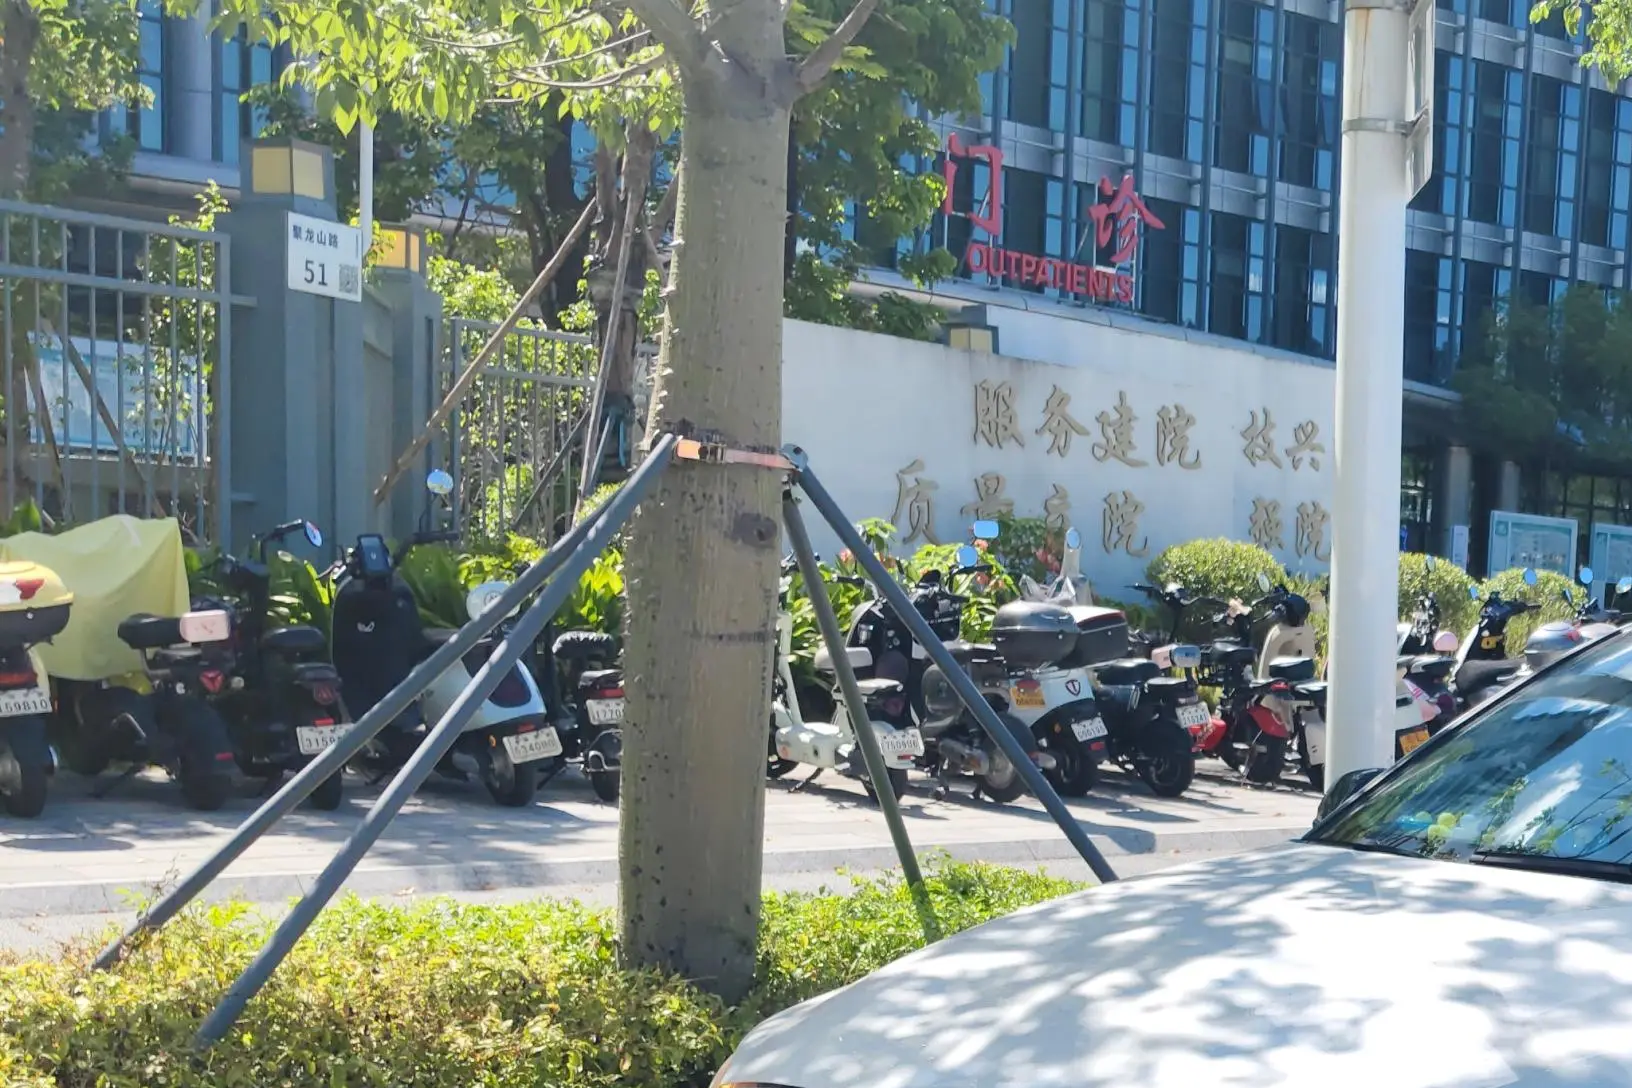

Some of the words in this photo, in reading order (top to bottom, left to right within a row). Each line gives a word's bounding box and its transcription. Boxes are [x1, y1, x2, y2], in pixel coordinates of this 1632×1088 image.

[944, 132, 1165, 262] 门诊
[304, 258, 328, 286] 51
[967, 244, 1134, 303] OUTPATIENTS
[974, 378, 1203, 471] 服务建院
